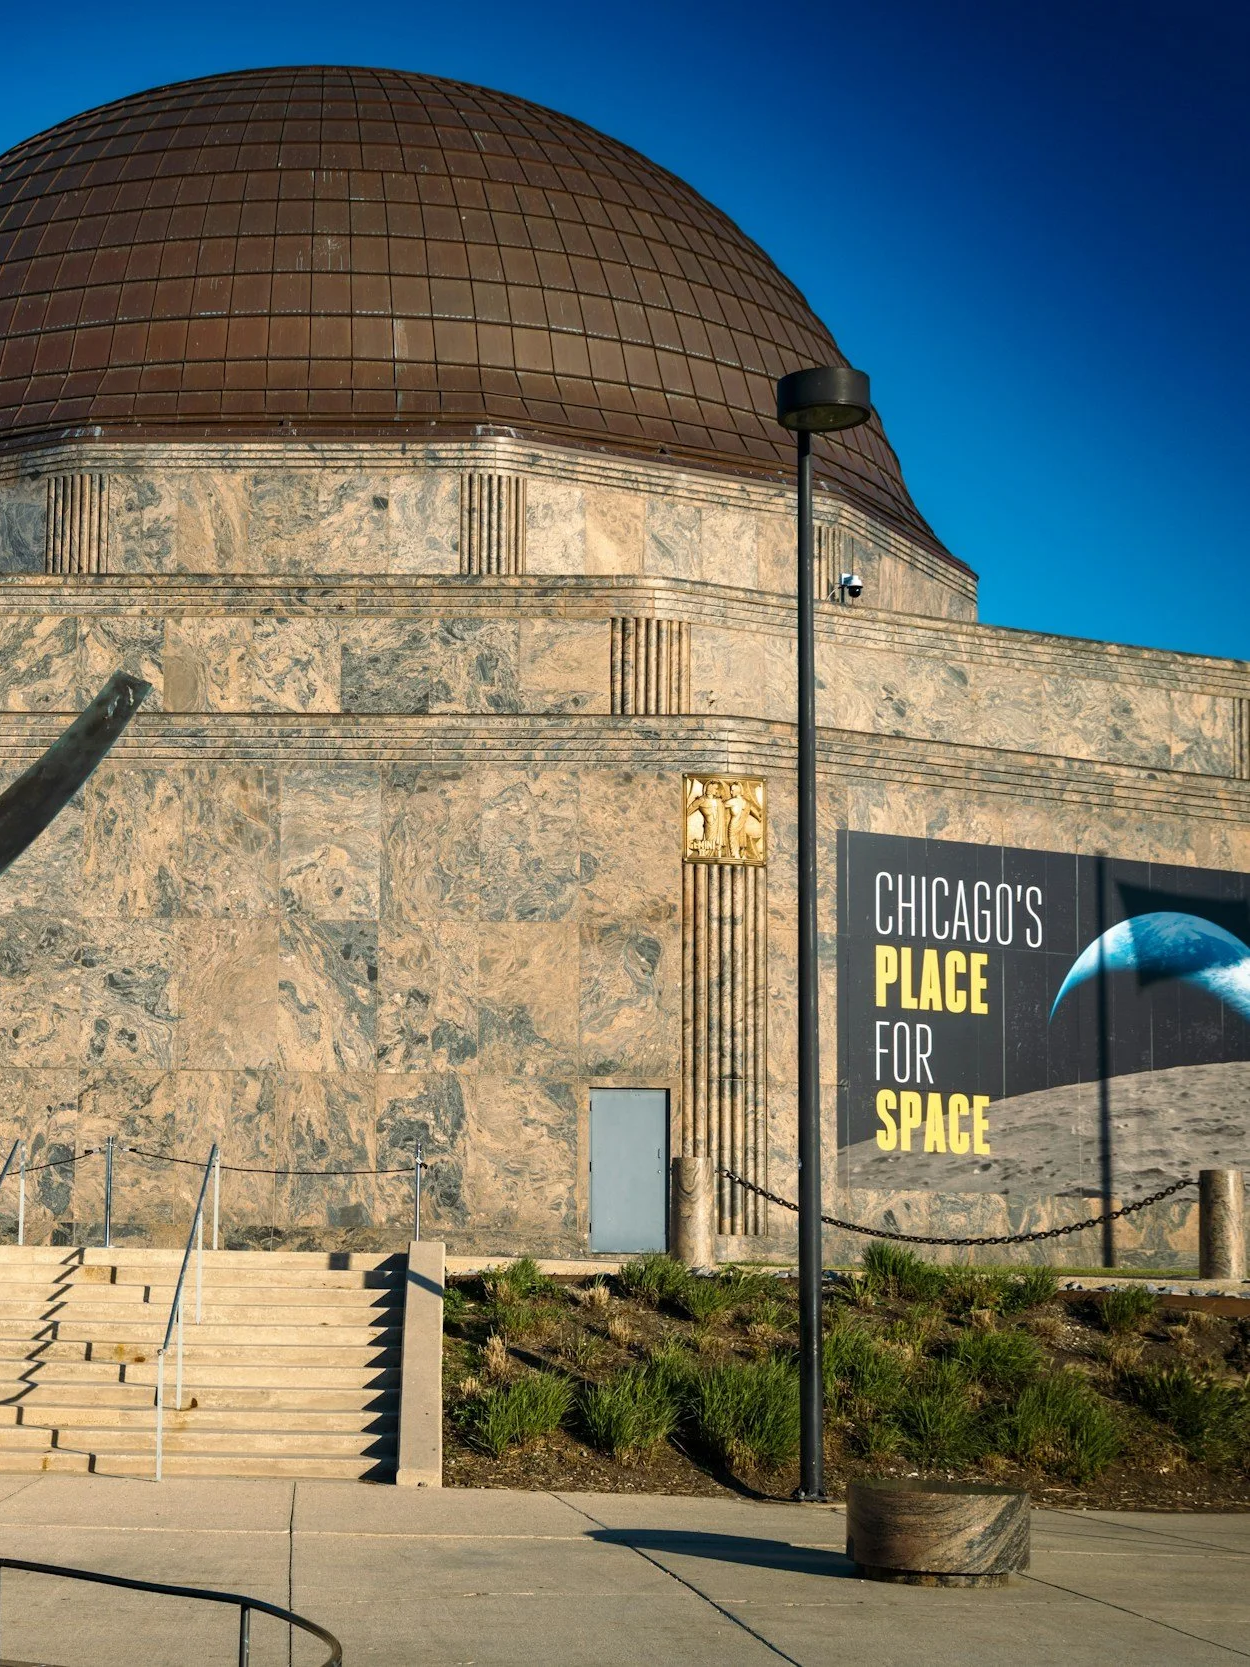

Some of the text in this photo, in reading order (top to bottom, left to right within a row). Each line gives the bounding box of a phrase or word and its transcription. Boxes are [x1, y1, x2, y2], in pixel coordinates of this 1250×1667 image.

[876, 872, 1043, 948] CHICAGO'S
[876, 945, 989, 1014] PLACE
[876, 1021, 934, 1084] FOR
[876, 1089, 990, 1156] SPACE
